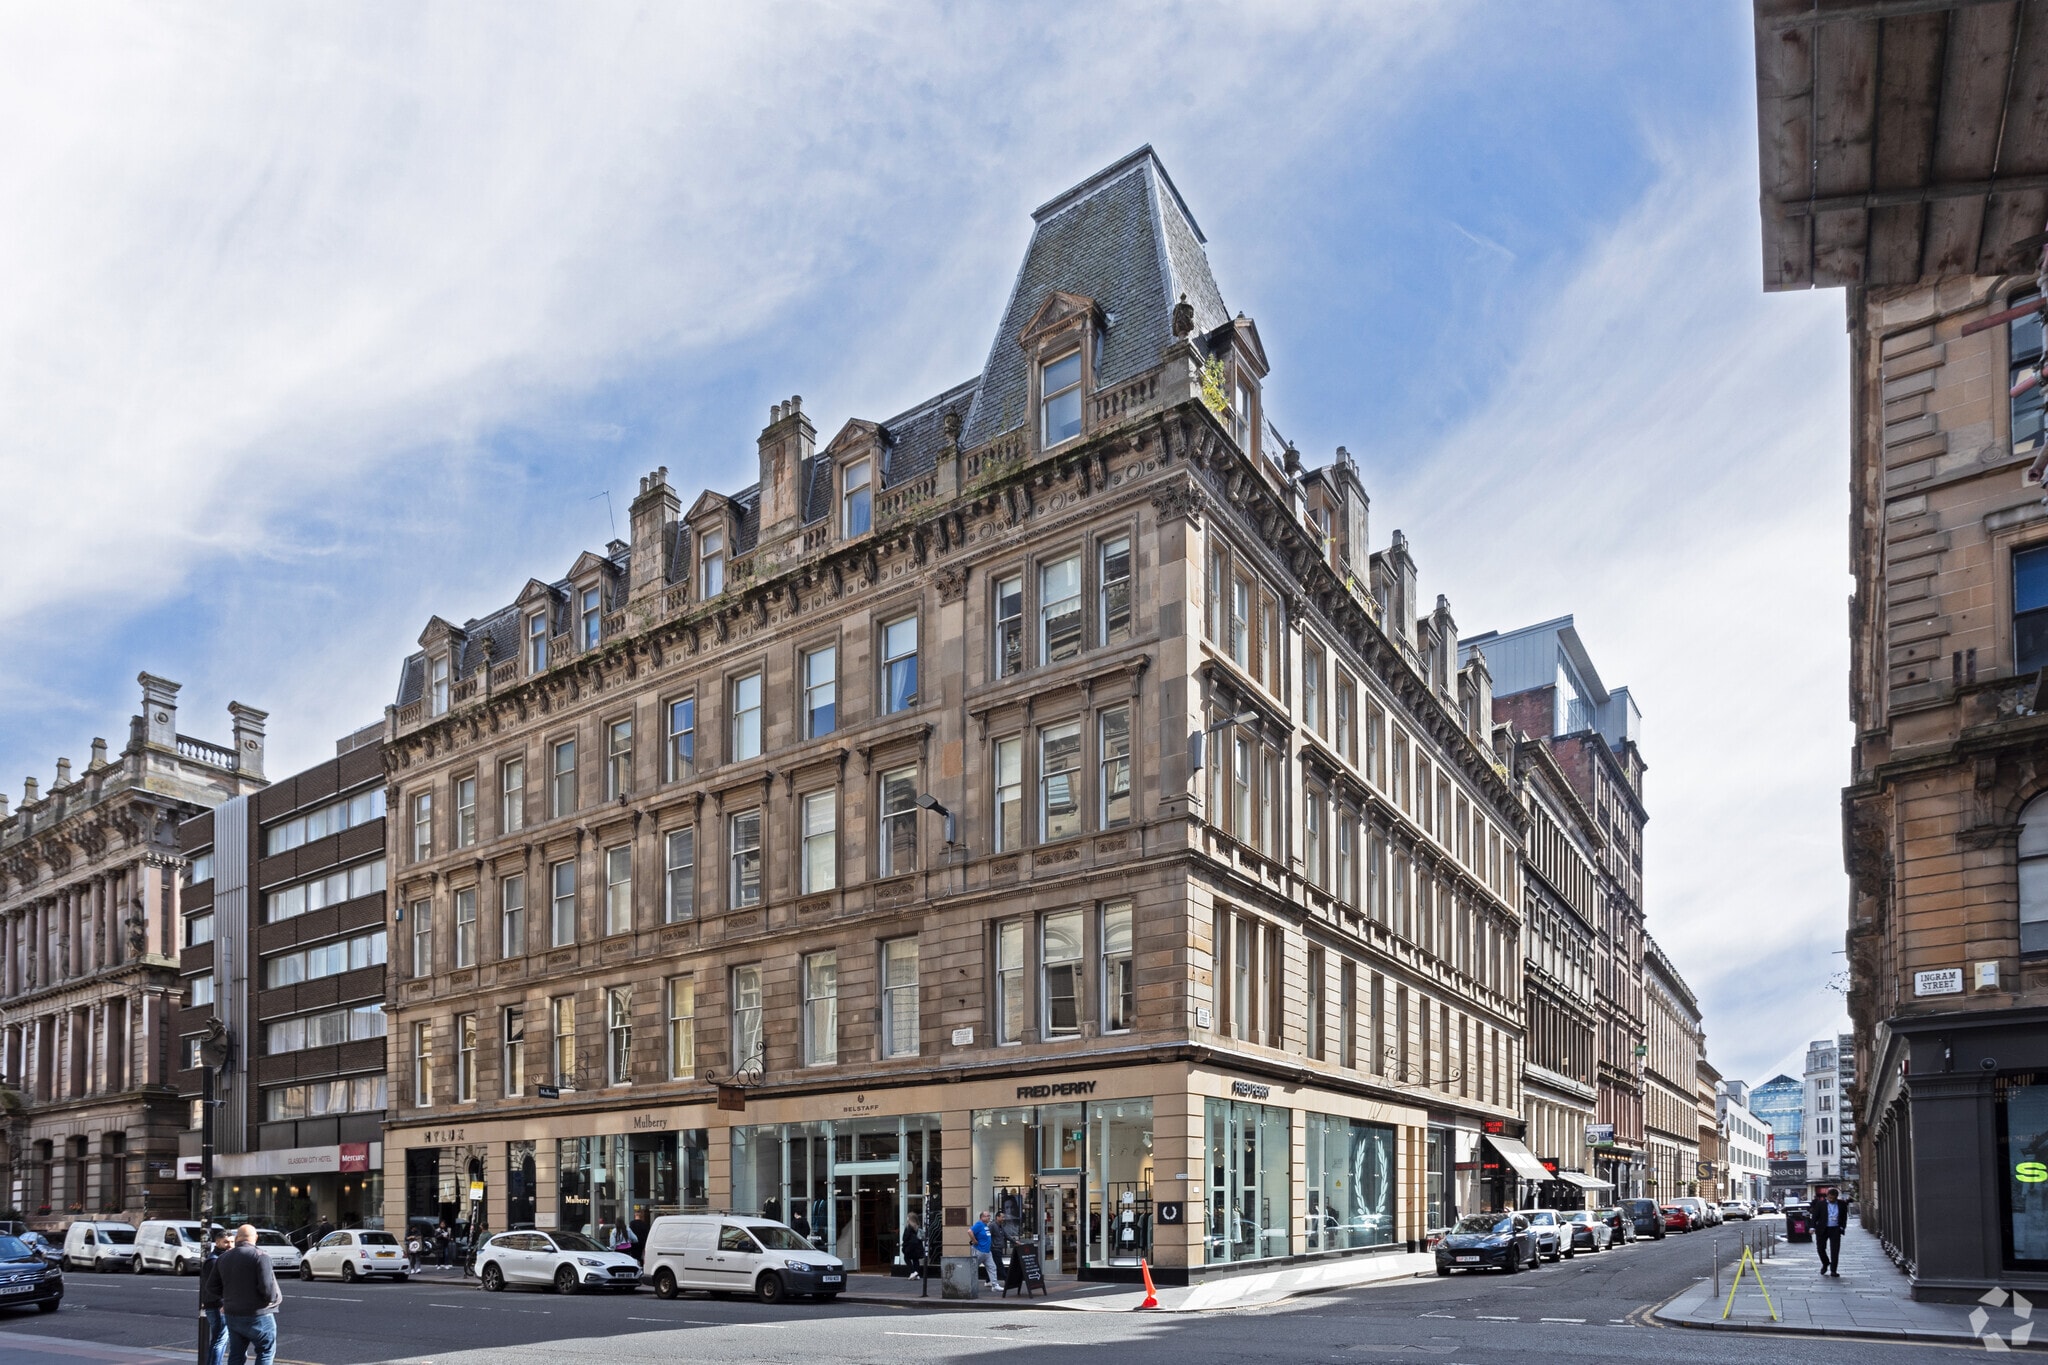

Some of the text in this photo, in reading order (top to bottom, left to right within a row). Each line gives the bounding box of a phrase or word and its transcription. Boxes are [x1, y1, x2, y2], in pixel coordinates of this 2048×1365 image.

[1920, 971, 1956, 982] INGRAM
[1922, 980, 1955, 990] STREET
[1016, 1080, 1097, 1099] FRED PERRY
[633, 1114, 668, 1130] Mulberry
[288, 1157, 308, 1165] GLASGOW
[341, 1154, 366, 1162] Mercure
[1771, 1168, 1801, 1176] NOCH
[565, 1194, 590, 1206] Mulberry
